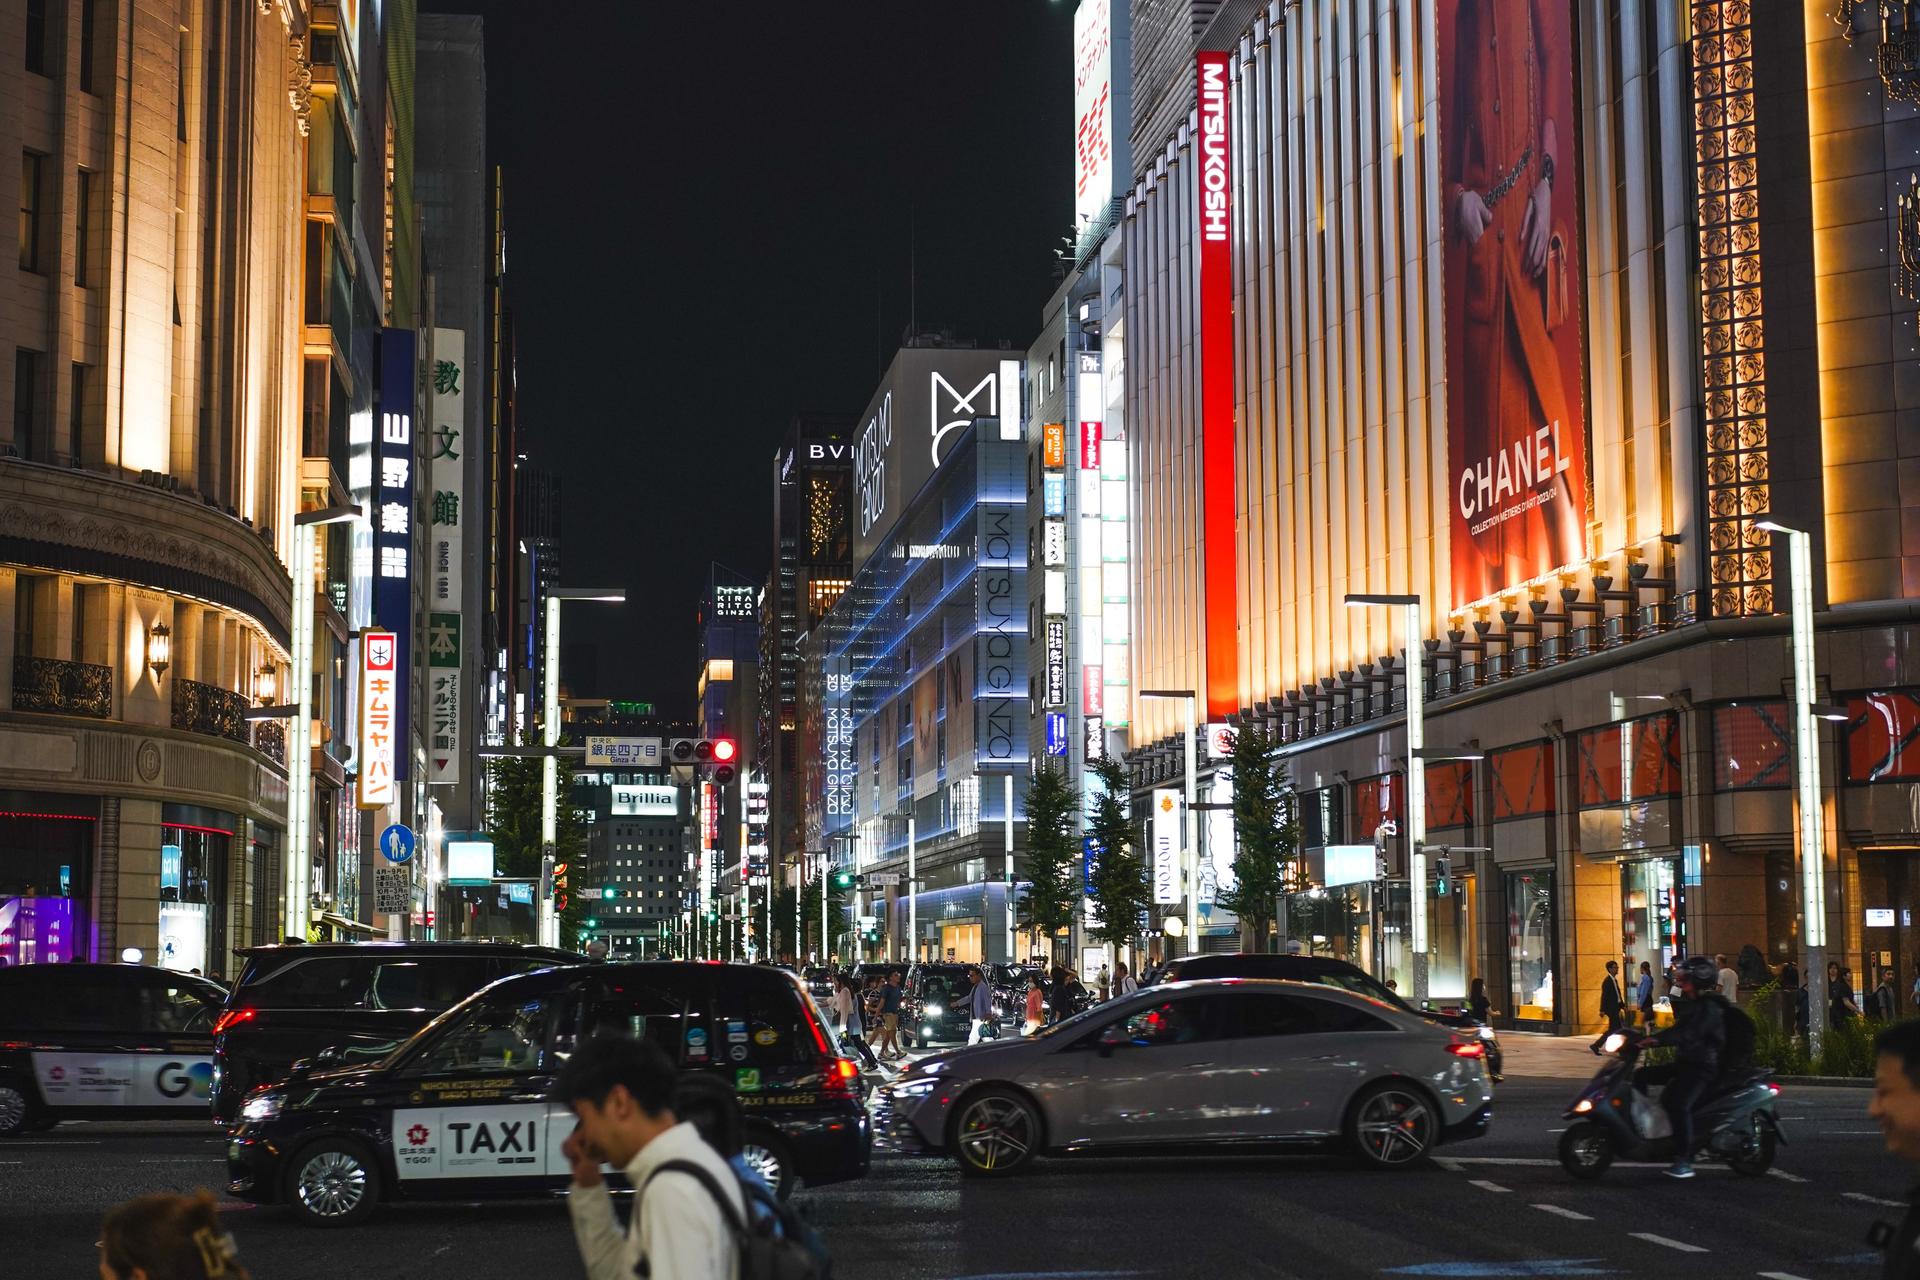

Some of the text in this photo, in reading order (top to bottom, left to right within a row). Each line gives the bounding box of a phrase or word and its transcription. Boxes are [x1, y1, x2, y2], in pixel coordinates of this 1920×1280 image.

[1203, 63, 1226, 241] MITSUKOSHI
[432, 360, 461, 526] 教文館
[1460, 420, 1569, 519] CHANEL
[381, 413, 409, 579] 山野楽器
[1471, 516, 1500, 536] COLLECTION
[440, 541, 449, 573] SINCE
[430, 622, 457, 658] 本
[369, 678, 392, 795] キムラヤのパン
[434, 677, 450, 749] ナルニア国
[591, 744, 657, 757] 銀座四丁目
[618, 792, 672, 804] Brillia
[448, 1120, 536, 1154] TAXI
